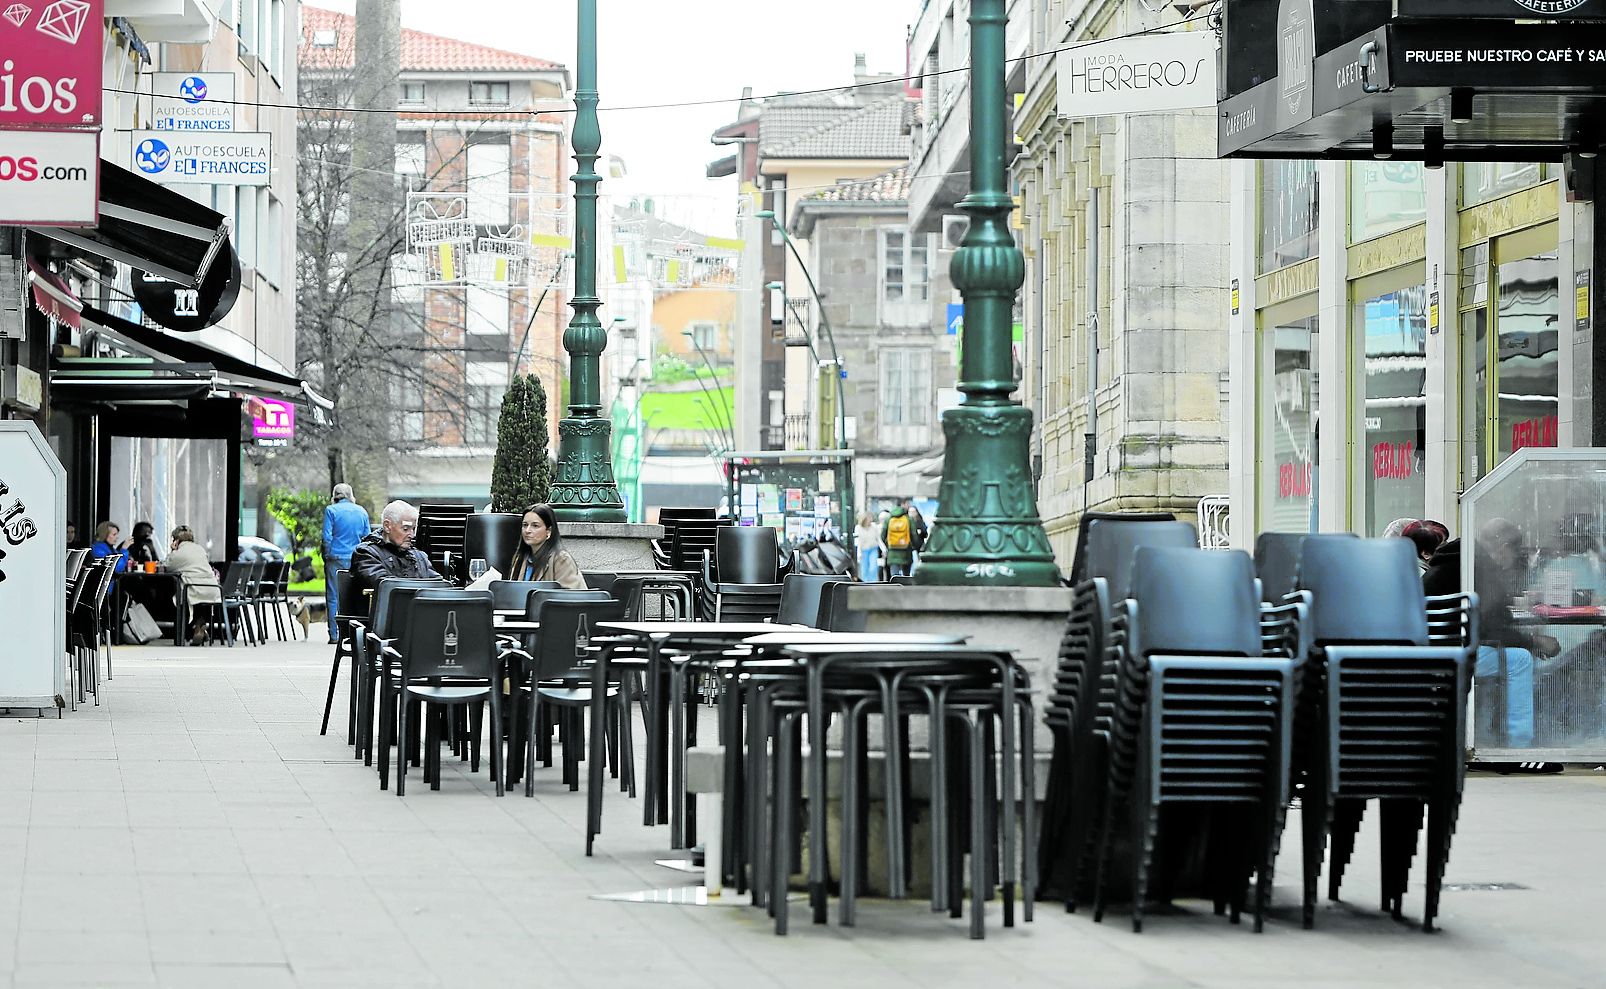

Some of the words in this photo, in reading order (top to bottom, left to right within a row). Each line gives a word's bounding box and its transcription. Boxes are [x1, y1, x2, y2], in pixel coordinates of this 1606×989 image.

[1087, 54, 1125, 66] MODA
[1405, 50, 1463, 63] PRUEBE
[1467, 49, 1533, 62] NUESTRO
[1536, 47, 1573, 62] CAFÉ
[1576, 50, 1585, 62] Y
[1588, 49, 1606, 62] SA
[1071, 57, 1206, 94] HERREROS
[0, 59, 77, 114] ios
[155, 107, 231, 116] AUTOESCUELA
[156, 118, 174, 130] EL
[177, 120, 231, 130] FRANCES
[174, 145, 267, 158] AUTOESCUELA
[174, 159, 197, 175] EL
[200, 161, 267, 174] FRANCES
[1373, 440, 1412, 480] REBAJAS
[1279, 461, 1312, 498] REBAJAS
